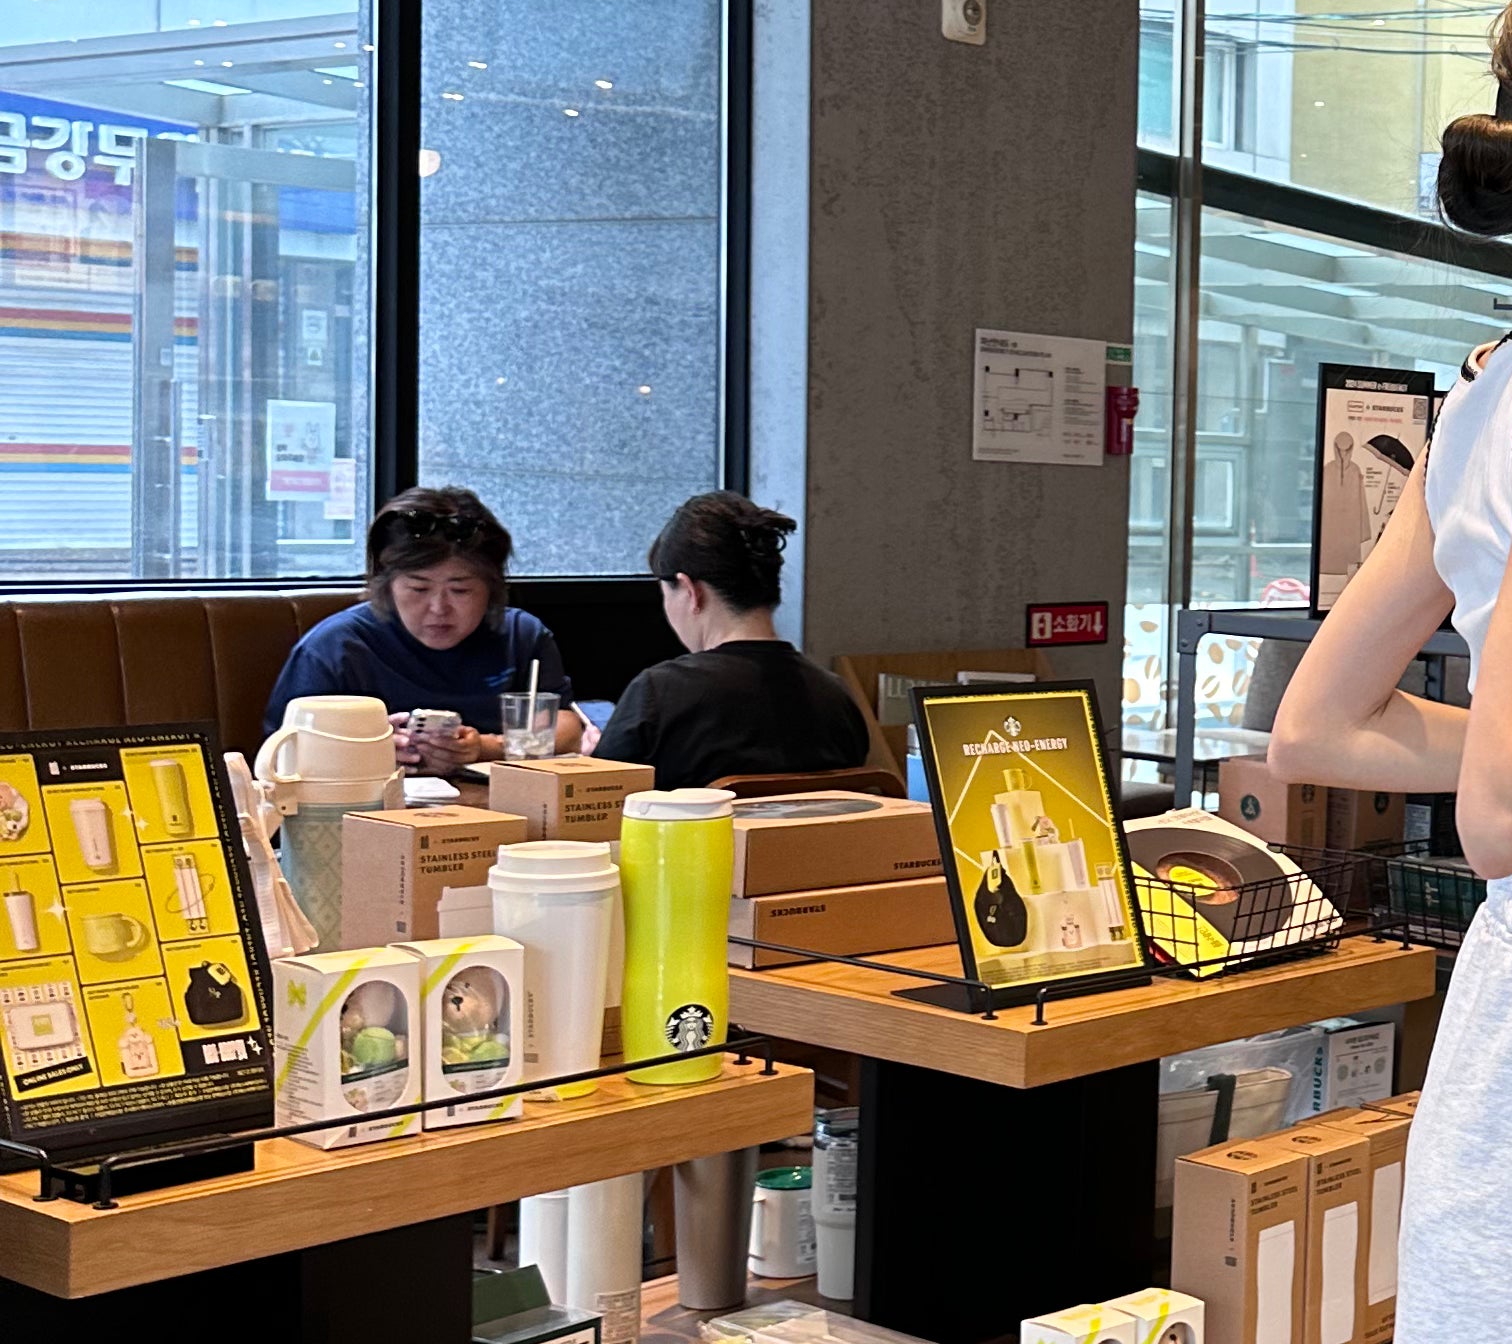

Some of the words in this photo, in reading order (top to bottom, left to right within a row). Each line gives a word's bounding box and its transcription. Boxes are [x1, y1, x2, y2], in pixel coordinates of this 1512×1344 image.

[1053, 613, 1093, 634] 소화기
[962, 741, 1012, 756] RECHARGE
[565, 801, 612, 812] STAINLESS
[565, 813, 608, 823] TUMBLER
[420, 851, 469, 864] STAINLESS
[420, 863, 464, 874] TUMBLER
